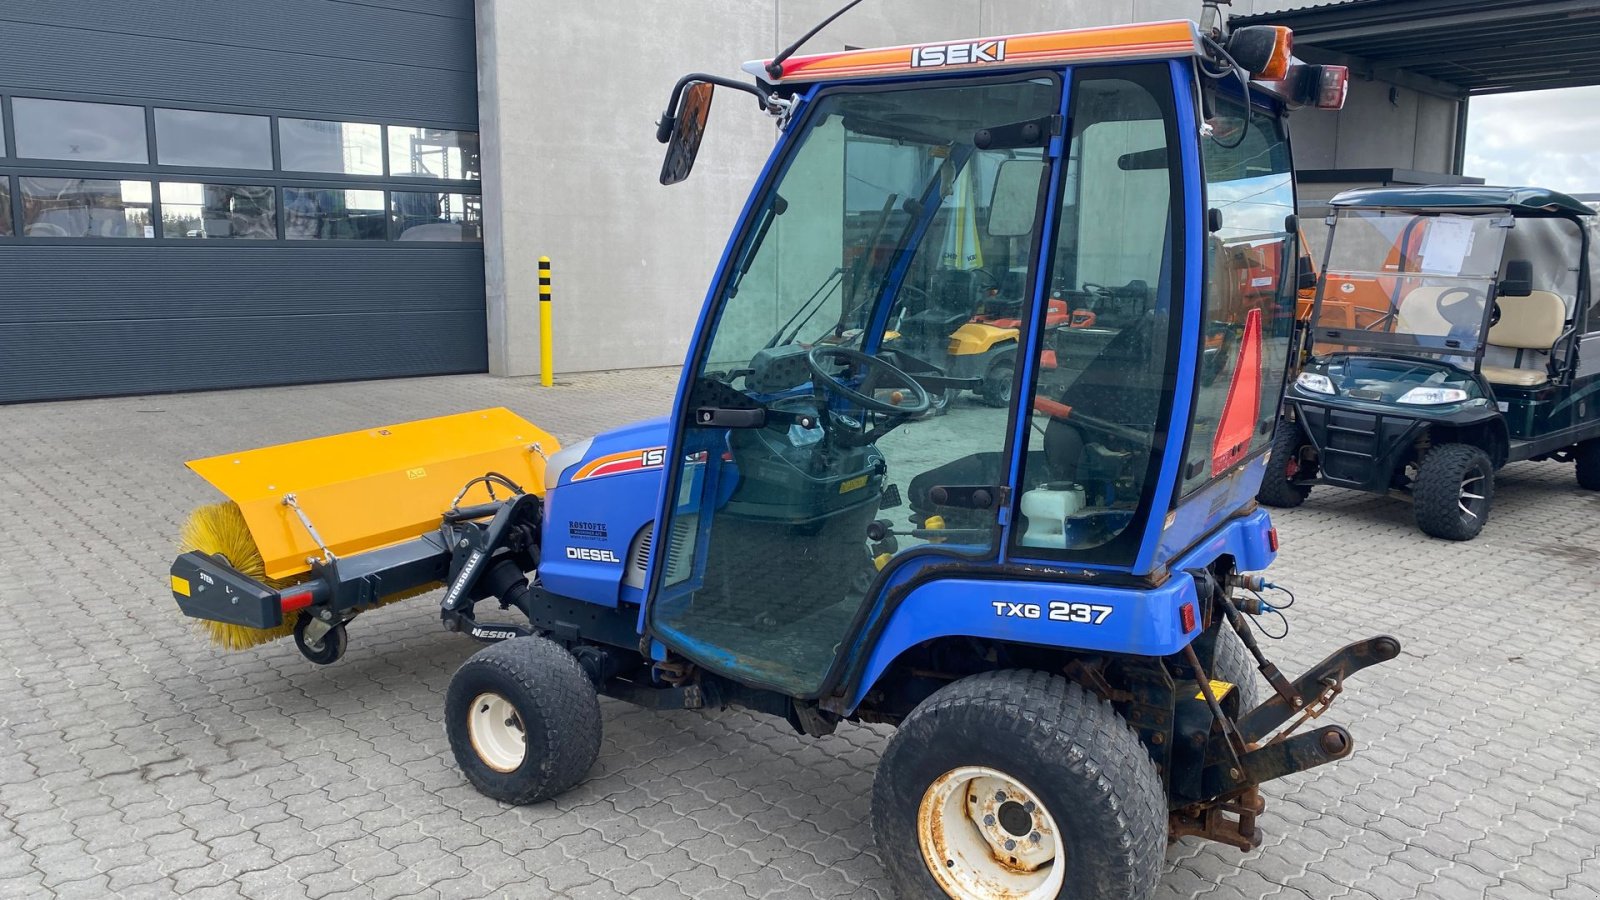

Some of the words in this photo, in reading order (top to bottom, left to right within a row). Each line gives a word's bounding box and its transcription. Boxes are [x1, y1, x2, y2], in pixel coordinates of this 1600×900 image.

[911, 40, 1006, 68] ISEKI
[565, 546, 620, 563] DIESEL
[992, 600, 1041, 619] TXG
[1048, 600, 1114, 626] 237
[471, 627, 517, 639] NESBO
